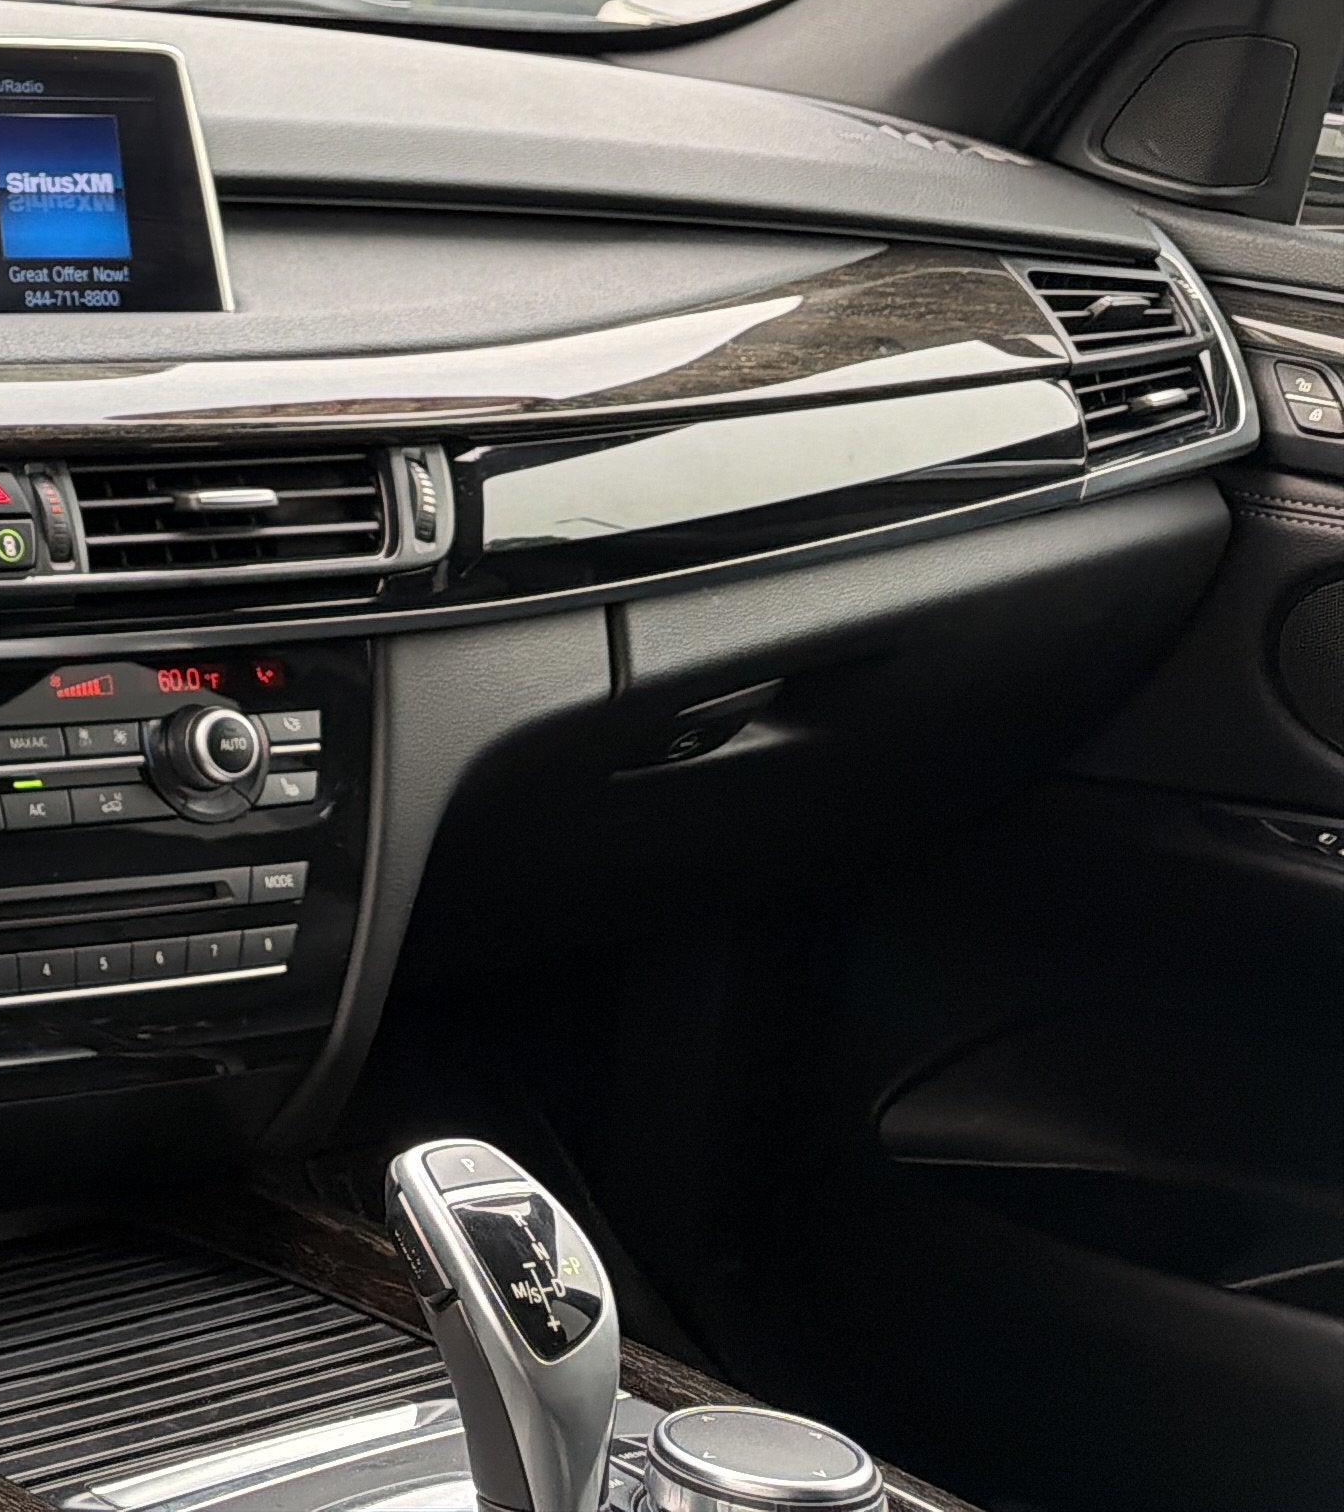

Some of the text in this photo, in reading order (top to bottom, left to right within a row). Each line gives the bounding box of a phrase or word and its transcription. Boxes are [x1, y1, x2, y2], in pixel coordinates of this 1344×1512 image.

[6, 173, 113, 193] SiriusXM
[9, 266, 129, 283] Great Offer Now!
[25, 291, 120, 307] 844-711-8800
[157, 668, 201, 693] 60.0
[220, 738, 247, 752] AUTO
[29, 803, 46, 817] A/C
[264, 874, 295, 889] MODE
[42, 963, 51, 977] 4
[99, 957, 108, 971] 5
[156, 951, 164, 965] 6
[460, 1157, 477, 1176] P
[512, 1211, 527, 1227] R
[532, 1243, 550, 1261] N
[571, 1257, 582, 1275] P
[510, 1279, 566, 1305] M/S D
